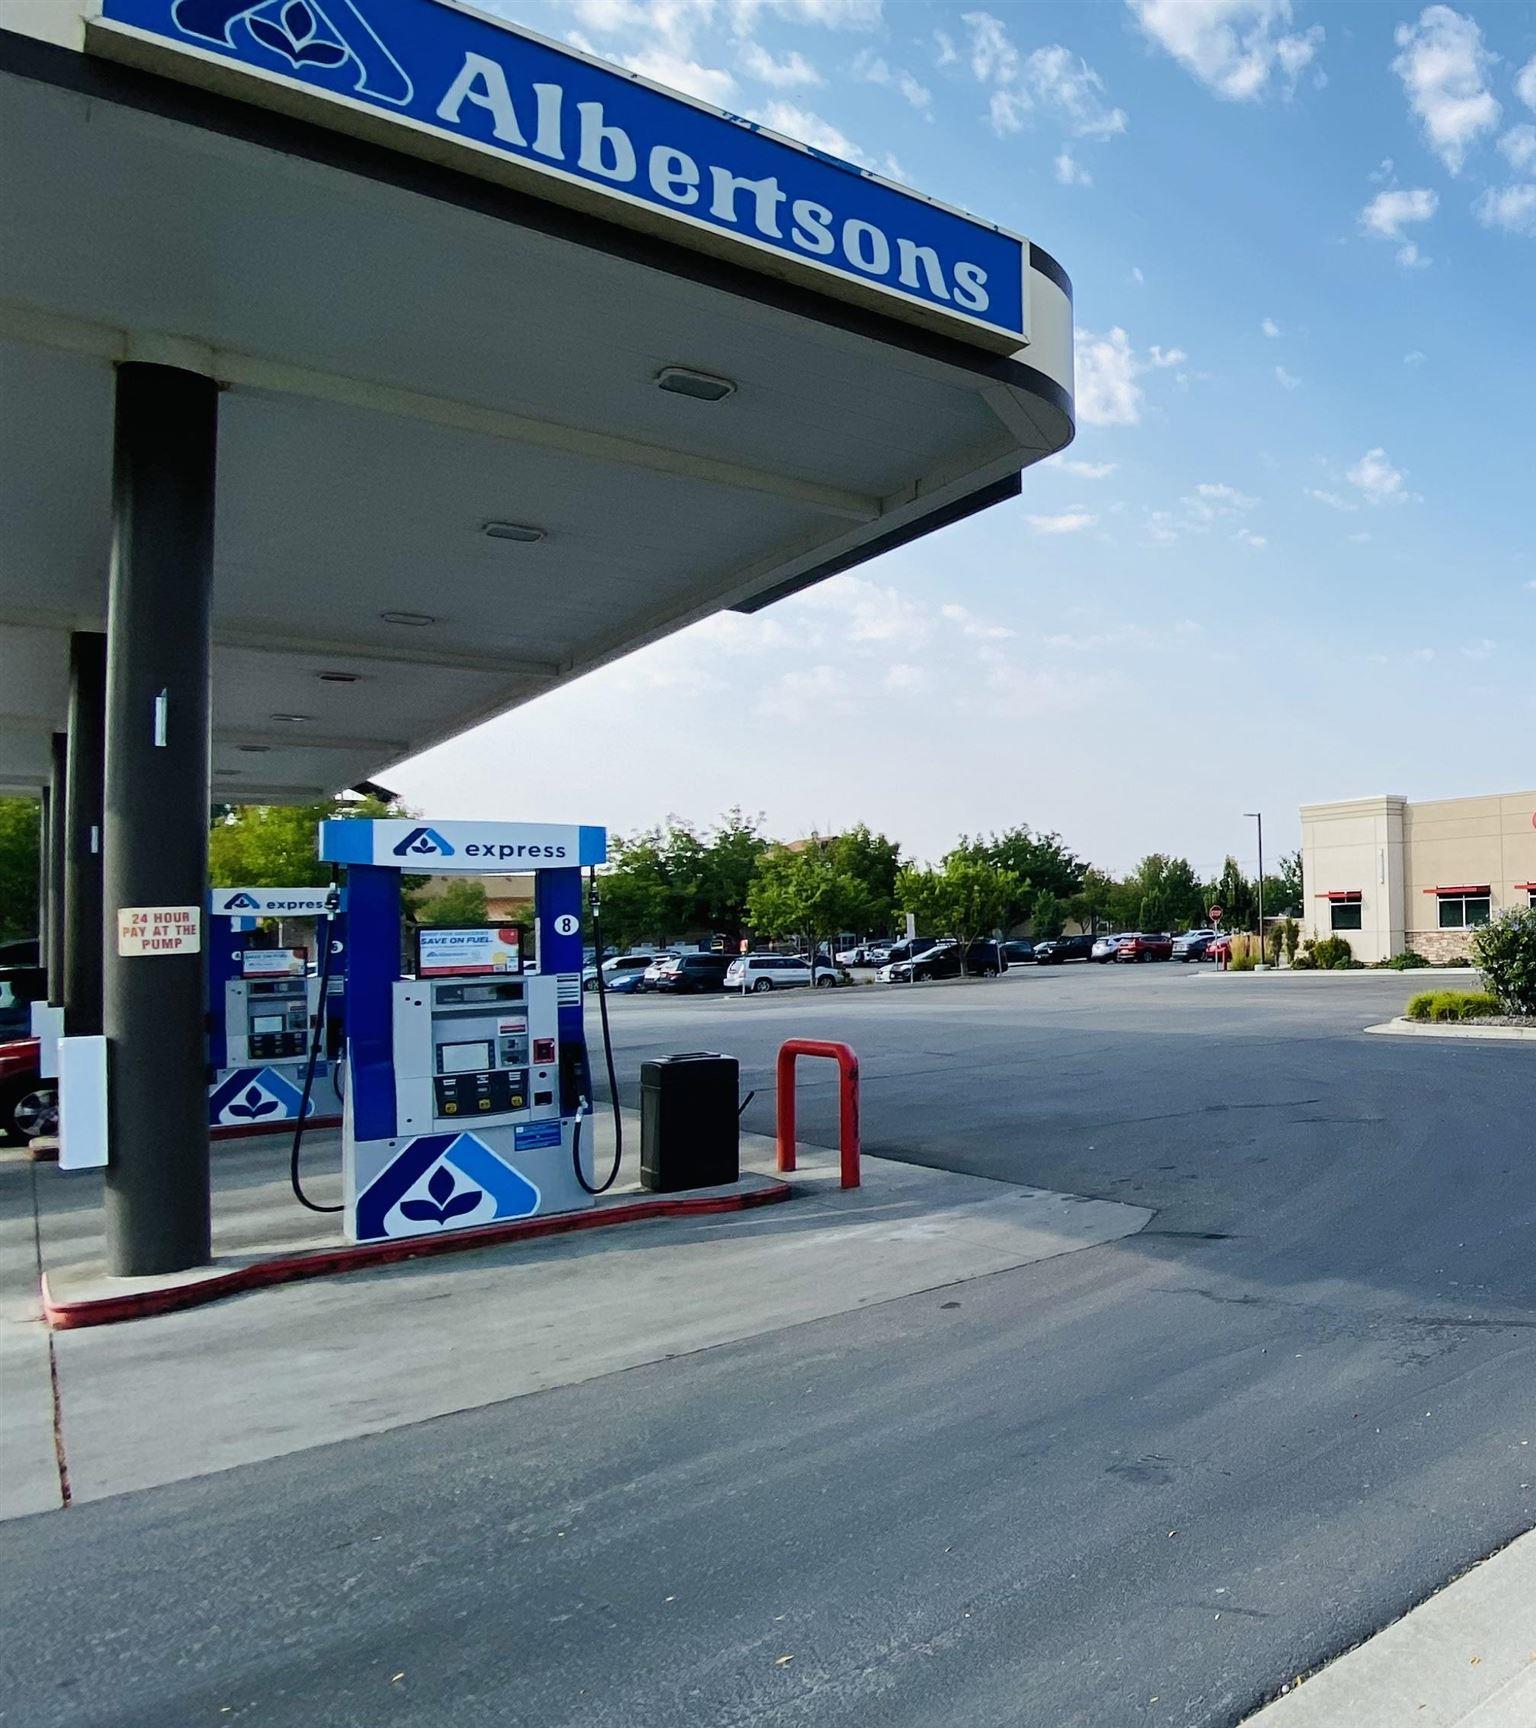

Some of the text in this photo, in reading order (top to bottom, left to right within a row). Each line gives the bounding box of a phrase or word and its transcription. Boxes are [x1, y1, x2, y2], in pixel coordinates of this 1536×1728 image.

[436, 51, 990, 313] Albertsons
[465, 843, 566, 860] express
[266, 900, 326, 910] expres
[132, 912, 189, 924] 24 HOUR
[123, 925, 196, 937] PAY AT THE
[562, 917, 571, 933] 8
[142, 938, 182, 949] PUMP
[421, 937, 447, 945] SAVE
